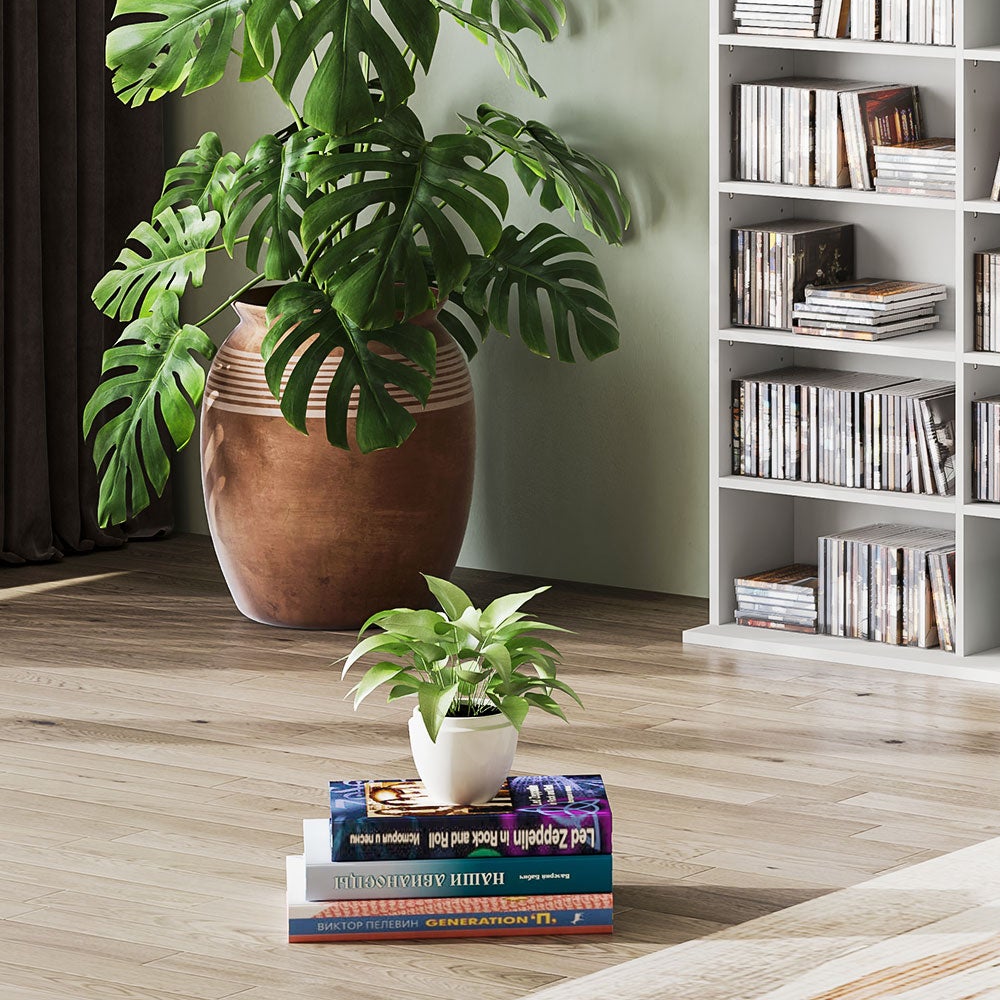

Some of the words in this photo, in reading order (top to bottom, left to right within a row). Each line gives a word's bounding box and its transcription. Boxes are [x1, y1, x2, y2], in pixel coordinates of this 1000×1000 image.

[382, 830, 420, 845] История
[428, 832, 449, 849] Roll
[451, 831, 470, 848] and
[471, 829, 498, 847] Rock
[500, 829, 509, 846] in
[513, 824, 569, 850] Zeppelin
[571, 827, 595, 846] Led
[333, 872, 446, 890] АВИАНОСЦЫ
[450, 871, 505, 888] НАШИ
[317, 921, 363, 931] ВИКТОР
[365, 919, 418, 930] ПЕЛЕВИН
[425, 915, 528, 927] GENERATION
